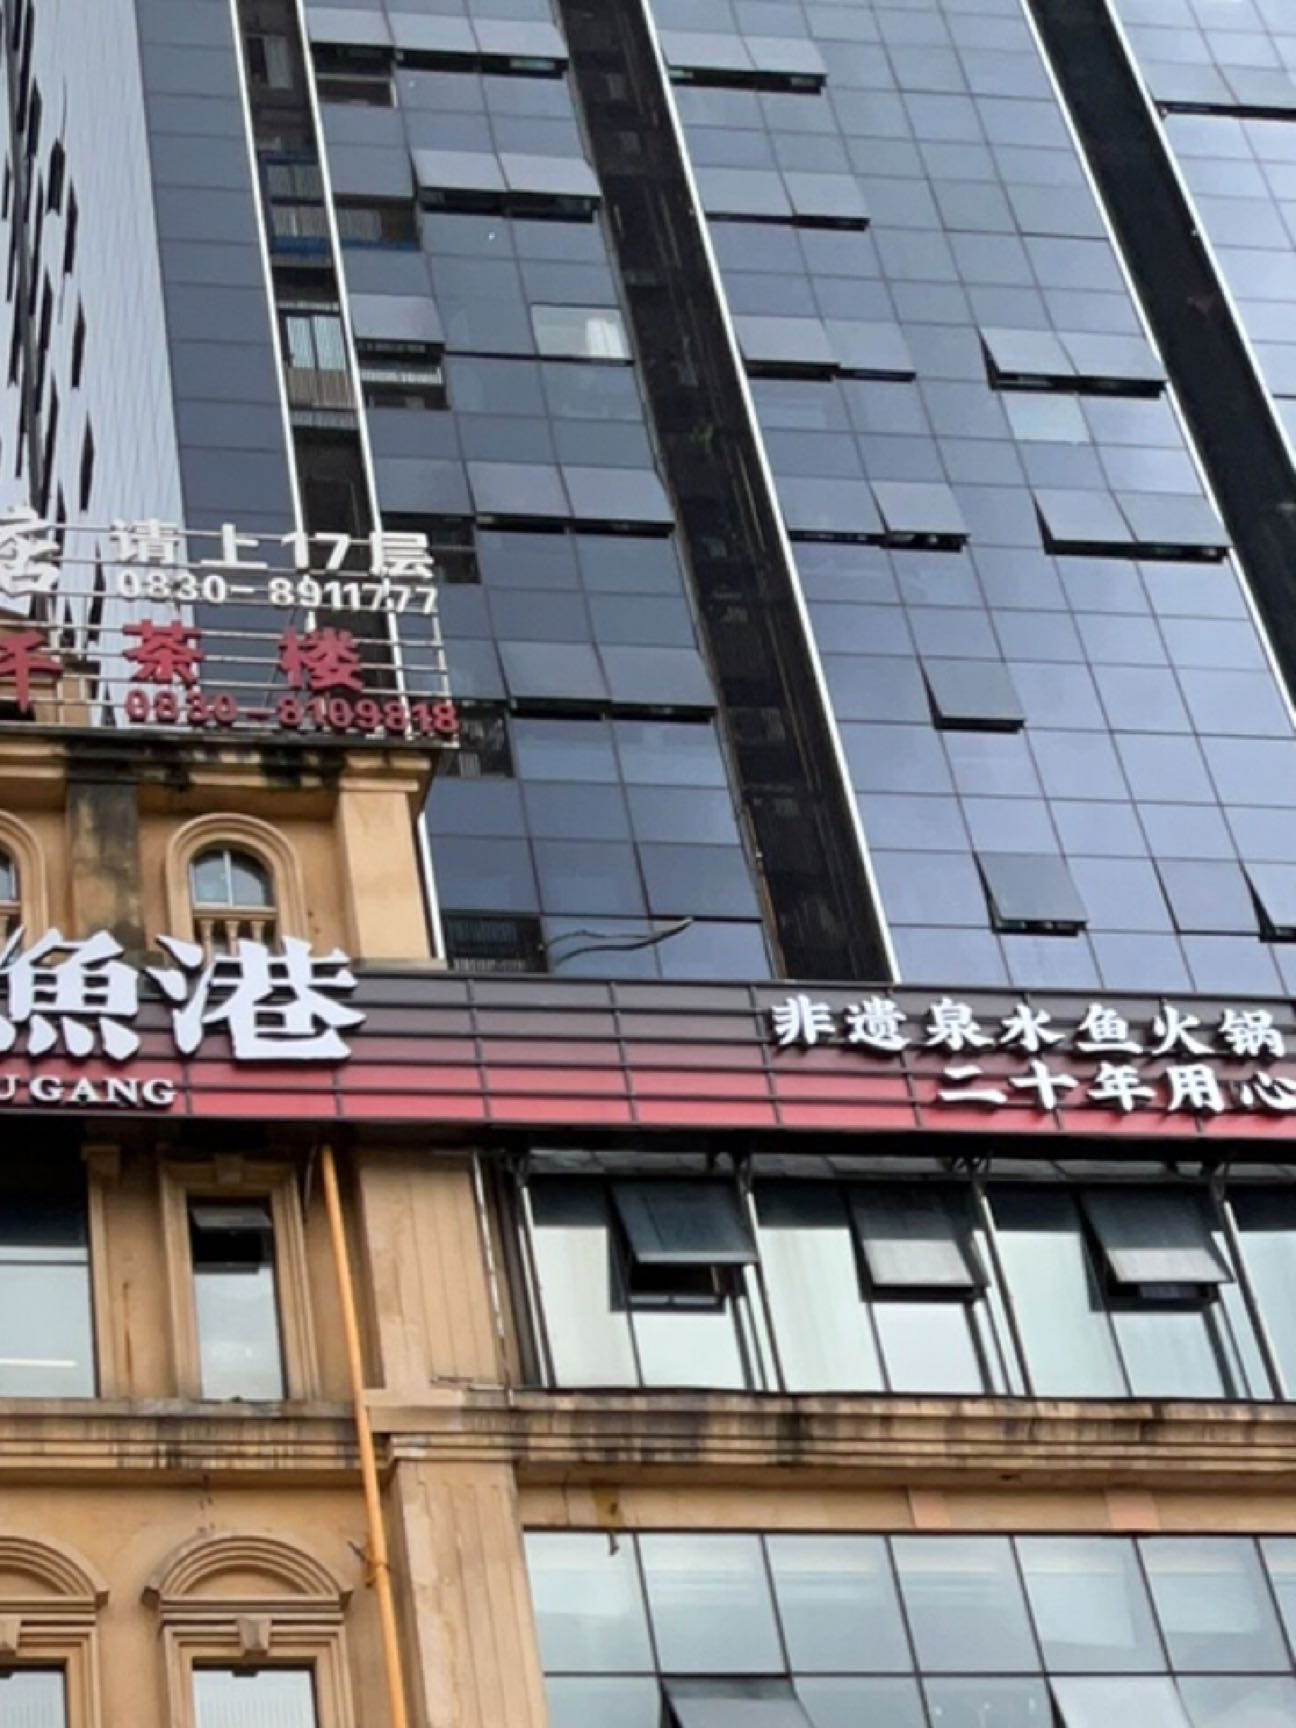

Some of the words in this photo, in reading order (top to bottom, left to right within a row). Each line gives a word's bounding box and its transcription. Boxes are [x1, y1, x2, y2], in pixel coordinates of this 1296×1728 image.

[109, 518, 435, 579] 请上17层
[116, 570, 438, 614] 0830-8911777
[770, 994, 1287, 1059] 非遗泉水鱼火锅
